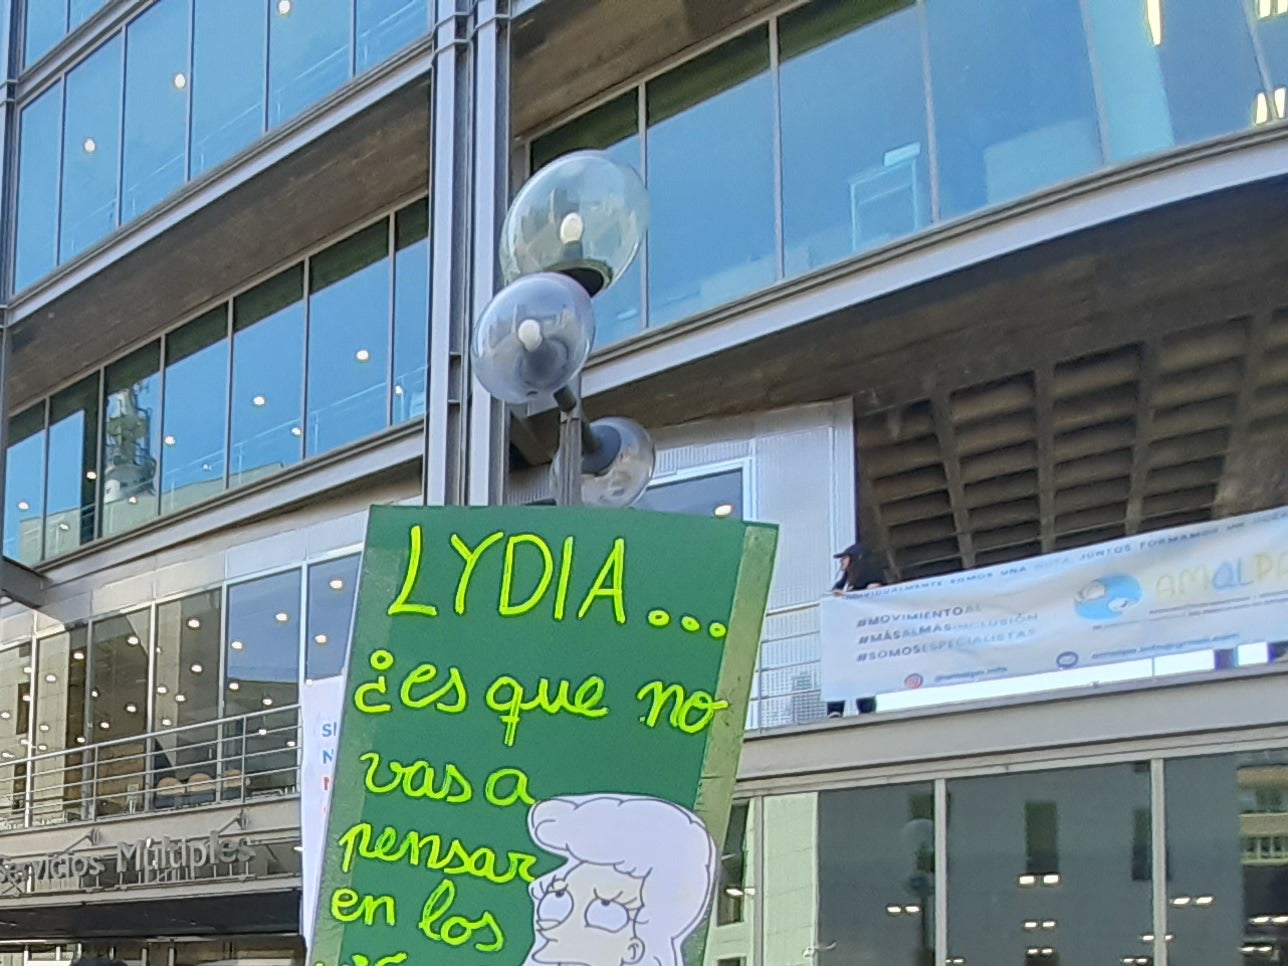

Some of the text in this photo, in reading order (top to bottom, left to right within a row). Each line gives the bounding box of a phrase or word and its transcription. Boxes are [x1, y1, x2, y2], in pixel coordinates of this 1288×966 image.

[387, 525, 727, 638] LYDIA...
[485, 674, 609, 747] que
[636, 680, 728, 735] no
[358, 751, 537, 806] vas a
[337, 823, 538, 884] pensar
[330, 880, 503, 952] en los
